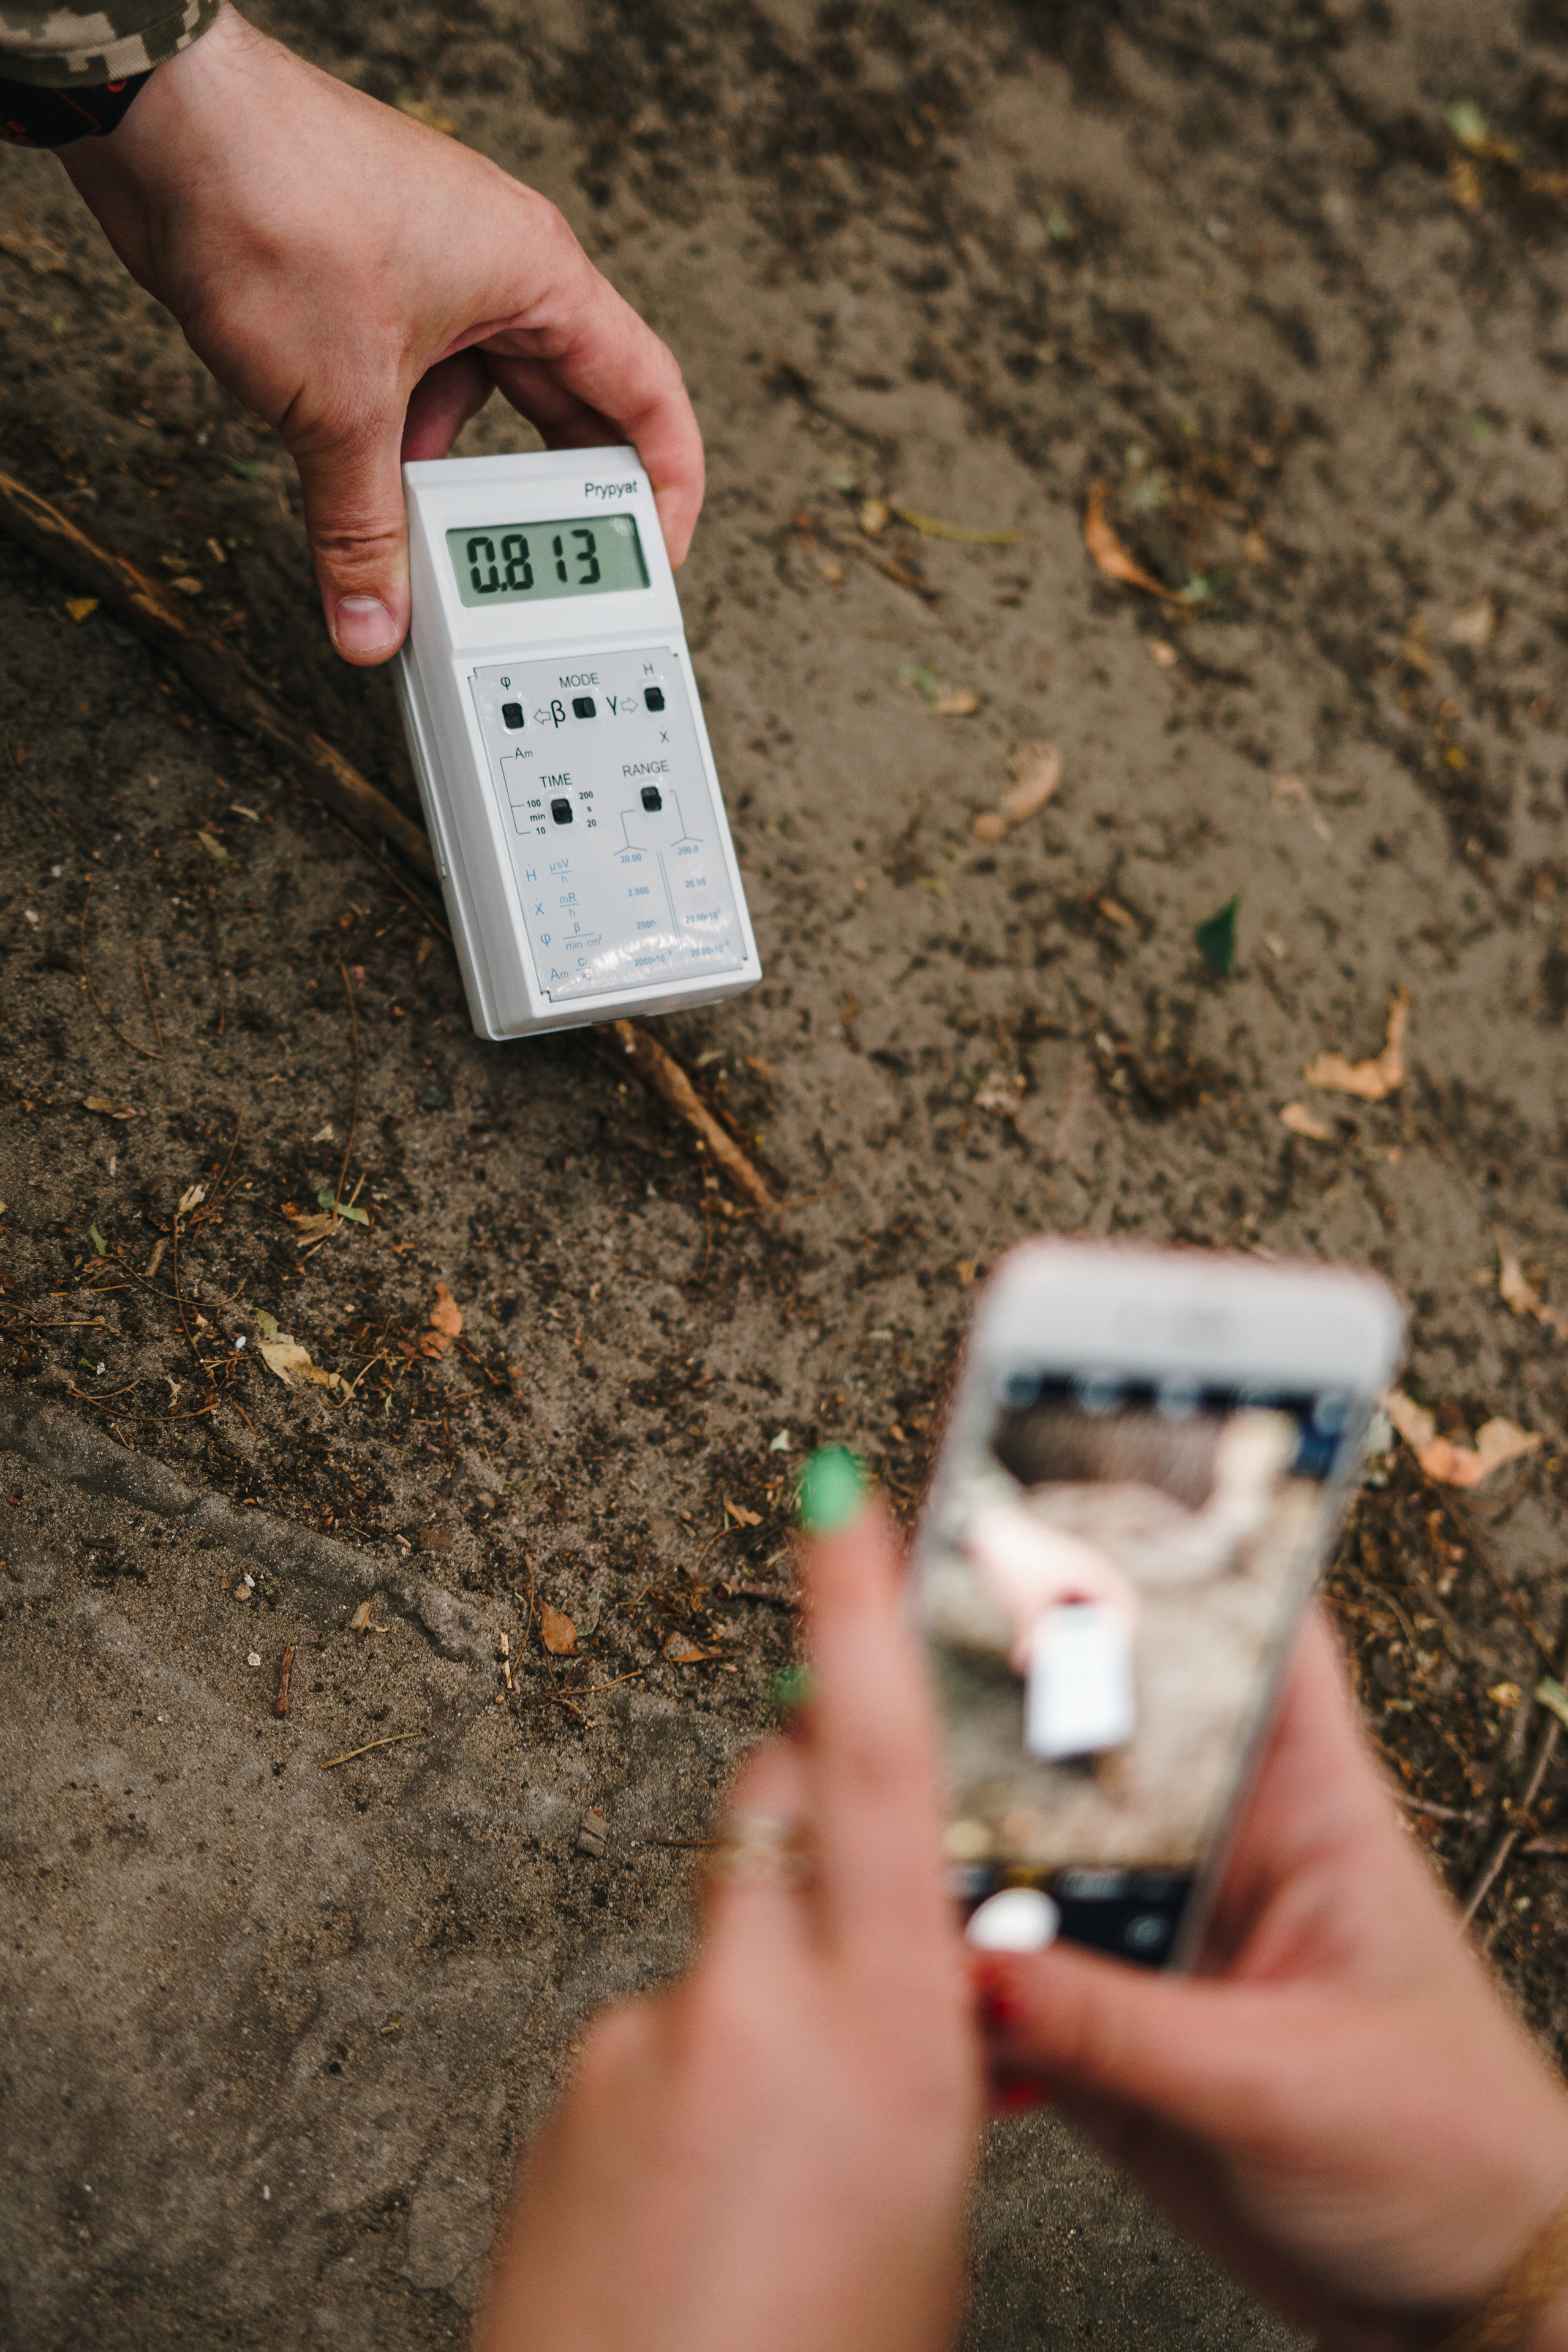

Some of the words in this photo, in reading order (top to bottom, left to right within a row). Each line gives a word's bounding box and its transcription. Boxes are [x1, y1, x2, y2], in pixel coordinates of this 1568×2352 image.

[584, 480, 638, 498] Prypyat
[559, 673, 600, 688] MODE
[514, 747, 533, 760] Am
[622, 760, 670, 777] RANGE
[538, 772, 573, 788] TIME
[579, 791, 594, 800] 200
[526, 799, 541, 808] 100
[530, 813, 546, 821] min
[587, 819, 597, 827] 20
[536, 826, 546, 835] 10
[677, 845, 699, 855] 200.0
[620, 853, 642, 864] 20.00
[560, 875, 568, 884] h
[628, 886, 649, 897] 2.000
[559, 892, 577, 903] mR
[568, 908, 576, 917] h
[636, 919, 656, 930] 2000
[551, 968, 569, 981] Am
